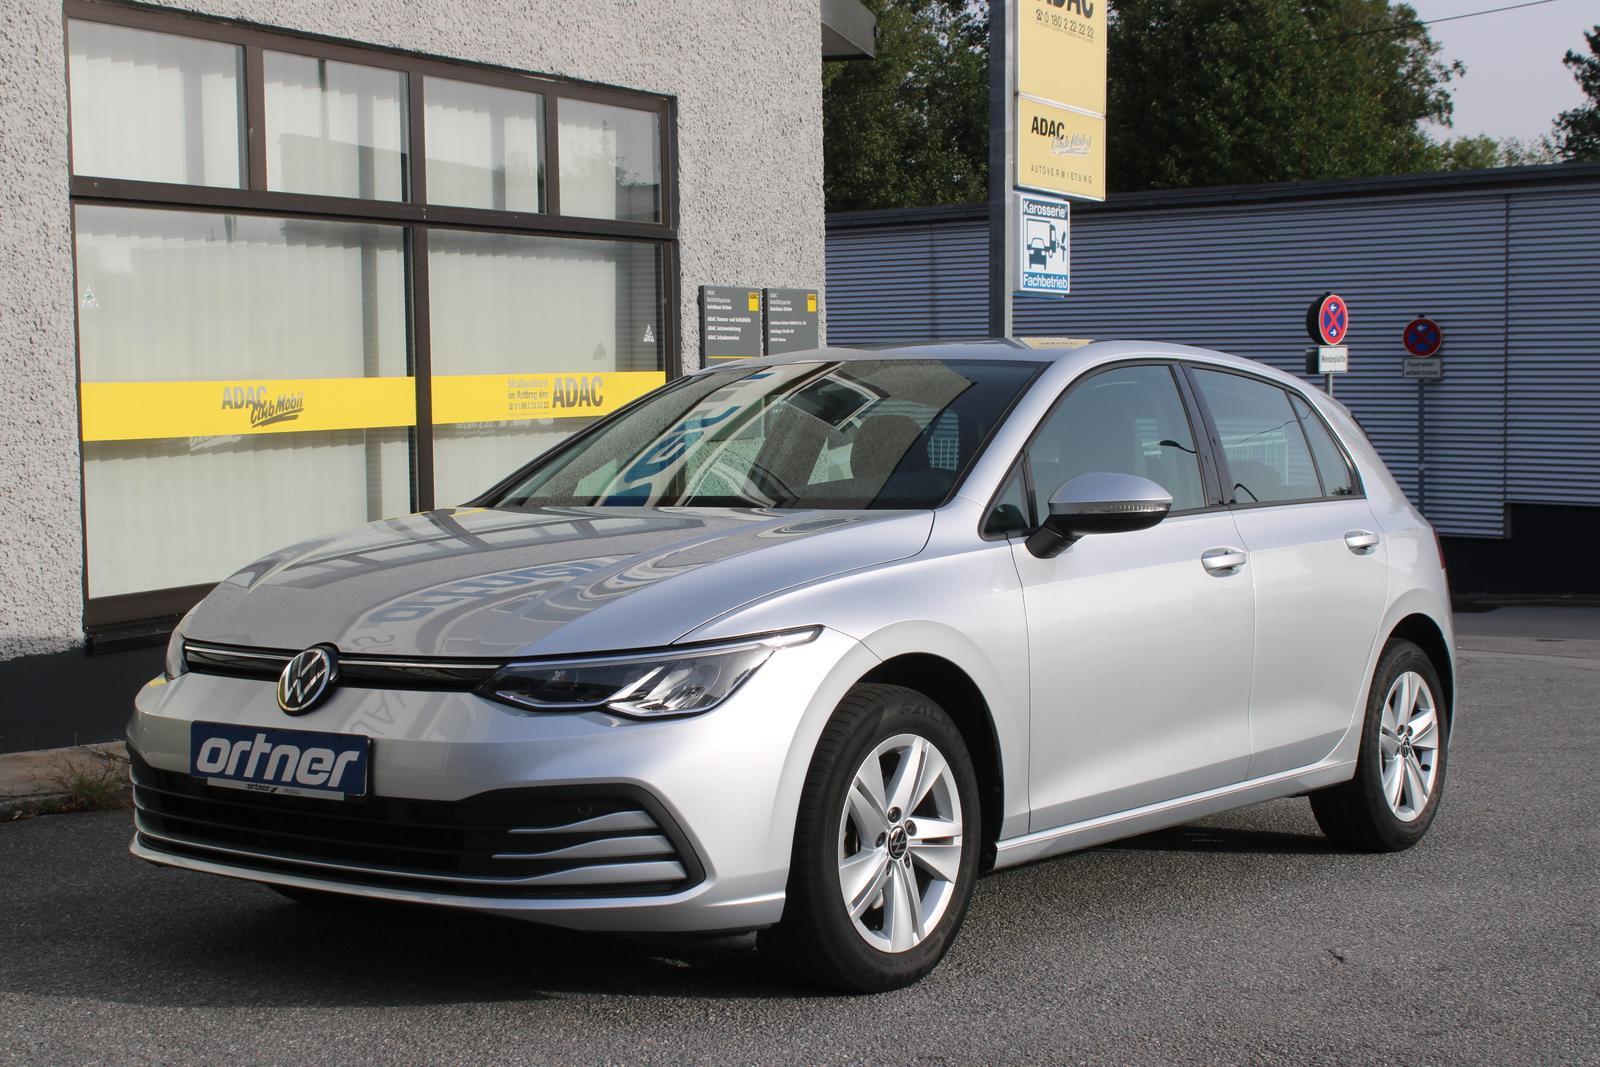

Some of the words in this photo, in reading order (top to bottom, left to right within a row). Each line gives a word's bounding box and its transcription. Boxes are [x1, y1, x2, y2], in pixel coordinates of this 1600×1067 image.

[1051, 14, 1061, 28] 180
[1064, 18, 1068, 30] 2
[1070, 20, 1076, 32] 22
[1031, 116, 1065, 140] ADAC
[1031, 164, 1093, 184] AUTOVERMIETUNG
[1023, 274, 1068, 289] Fachbetrieb
[222, 386, 267, 410] ADAC
[276, 392, 304, 414] Mobil
[552, 376, 604, 408] ADAC
[196, 733, 360, 788] ortner
